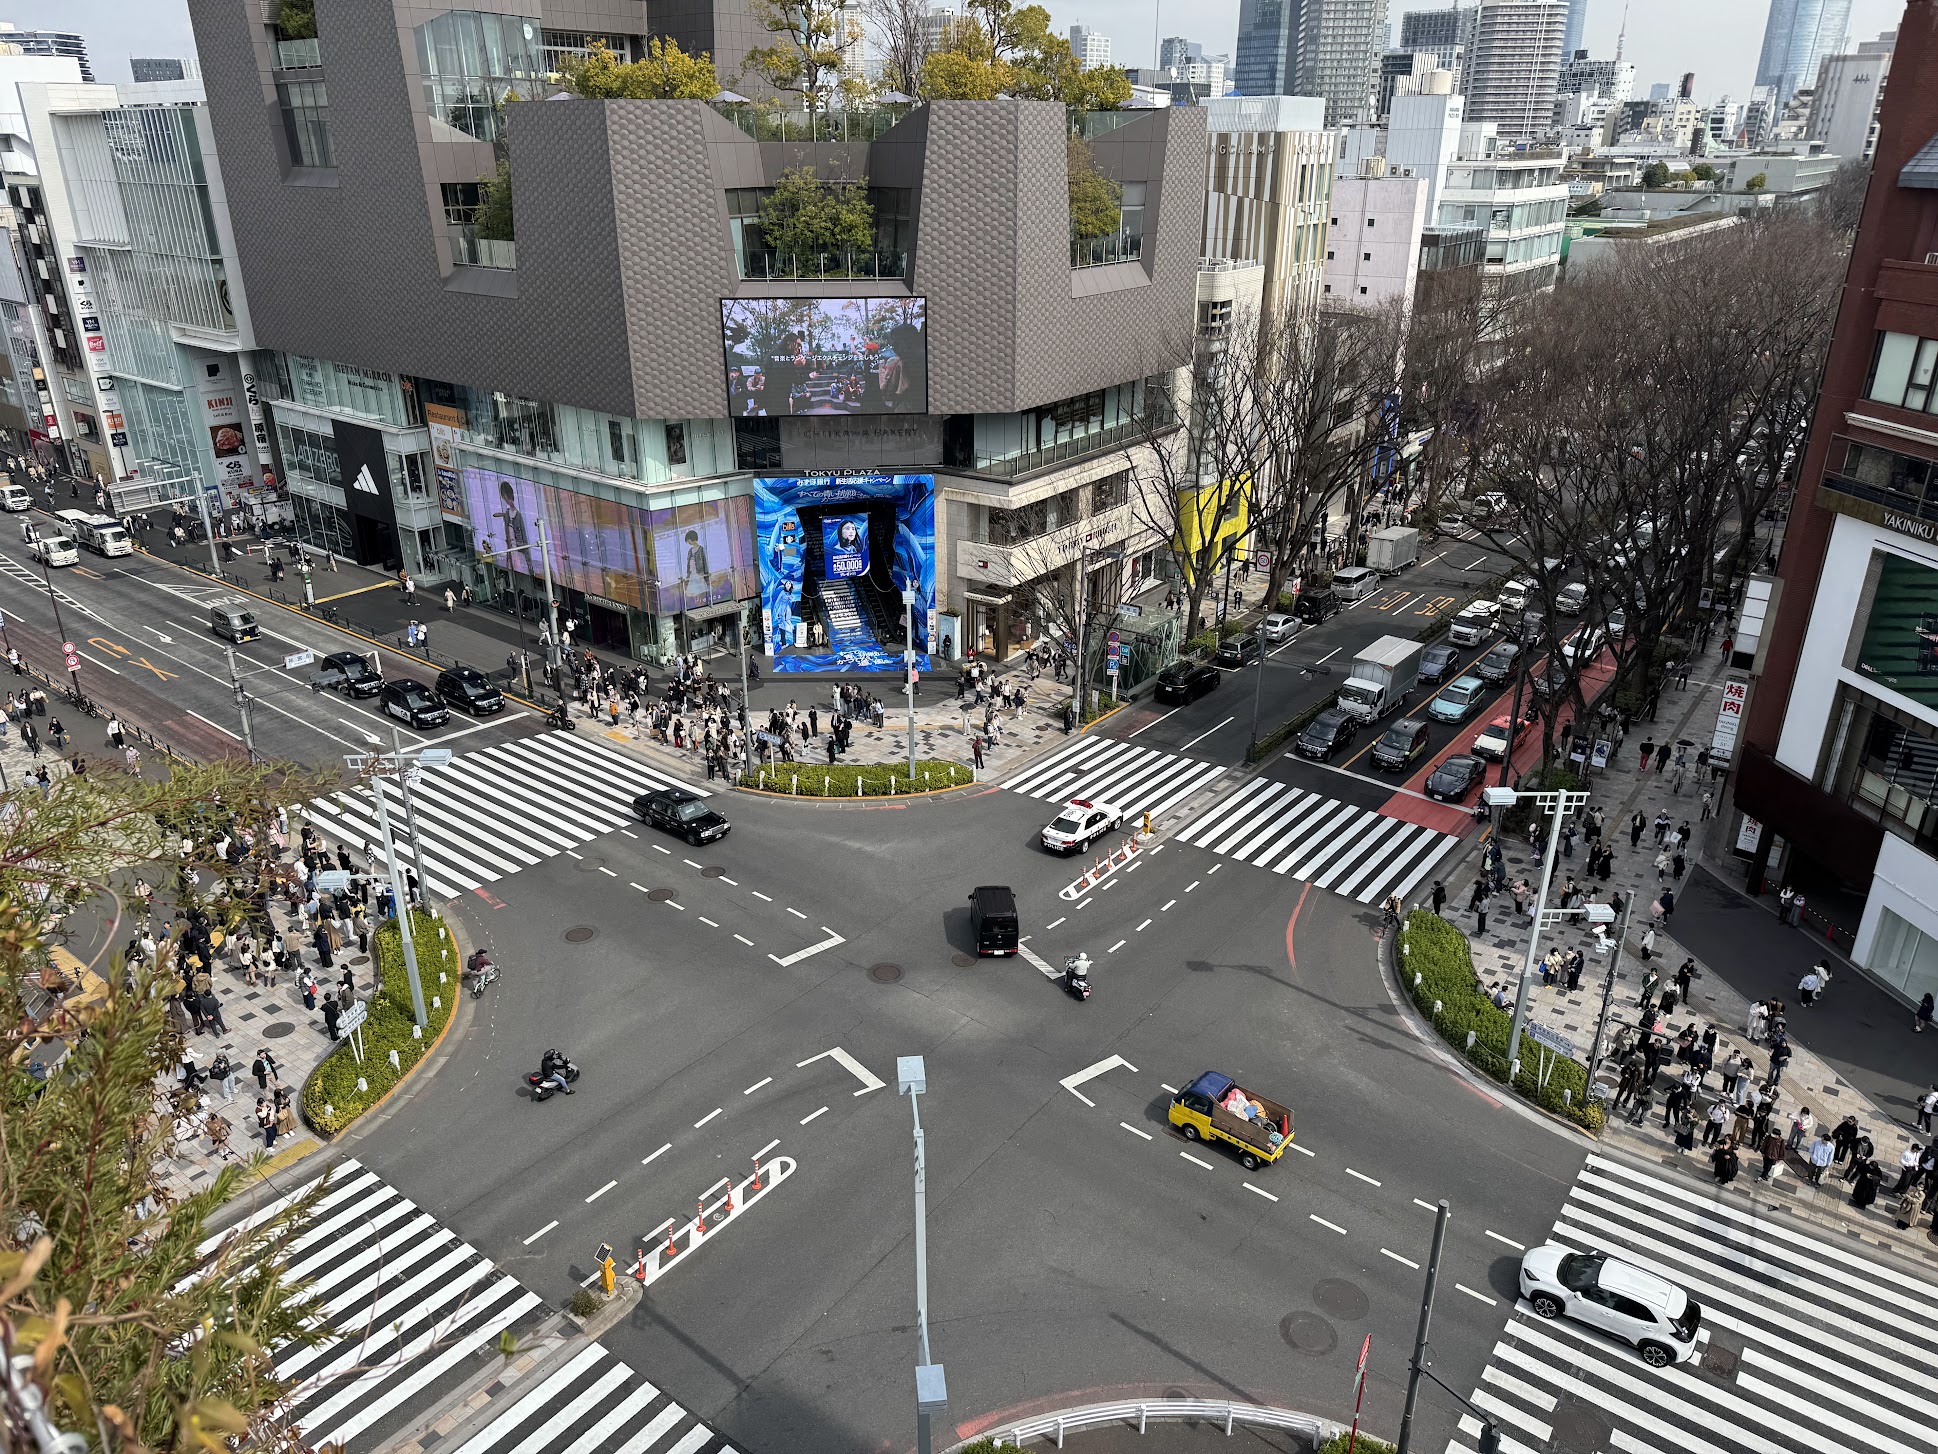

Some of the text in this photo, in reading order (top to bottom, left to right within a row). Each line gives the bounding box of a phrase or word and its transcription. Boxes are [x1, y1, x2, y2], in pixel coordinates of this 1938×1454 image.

[1204, 144, 1276, 155] NGCHAMP
[207, 397, 234, 410] KINJI
[803, 468, 881, 477] TOKYU PLAZA
[796, 477, 831, 486] みずほ銀行
[1883, 512, 1935, 540] YAKINIKU
[1414, 595, 1456, 616] 50
[1722, 683, 1745, 715] 焼肉
[1089, 825, 1107, 840] POLICE
[1043, 841, 1065, 852] POLICE
